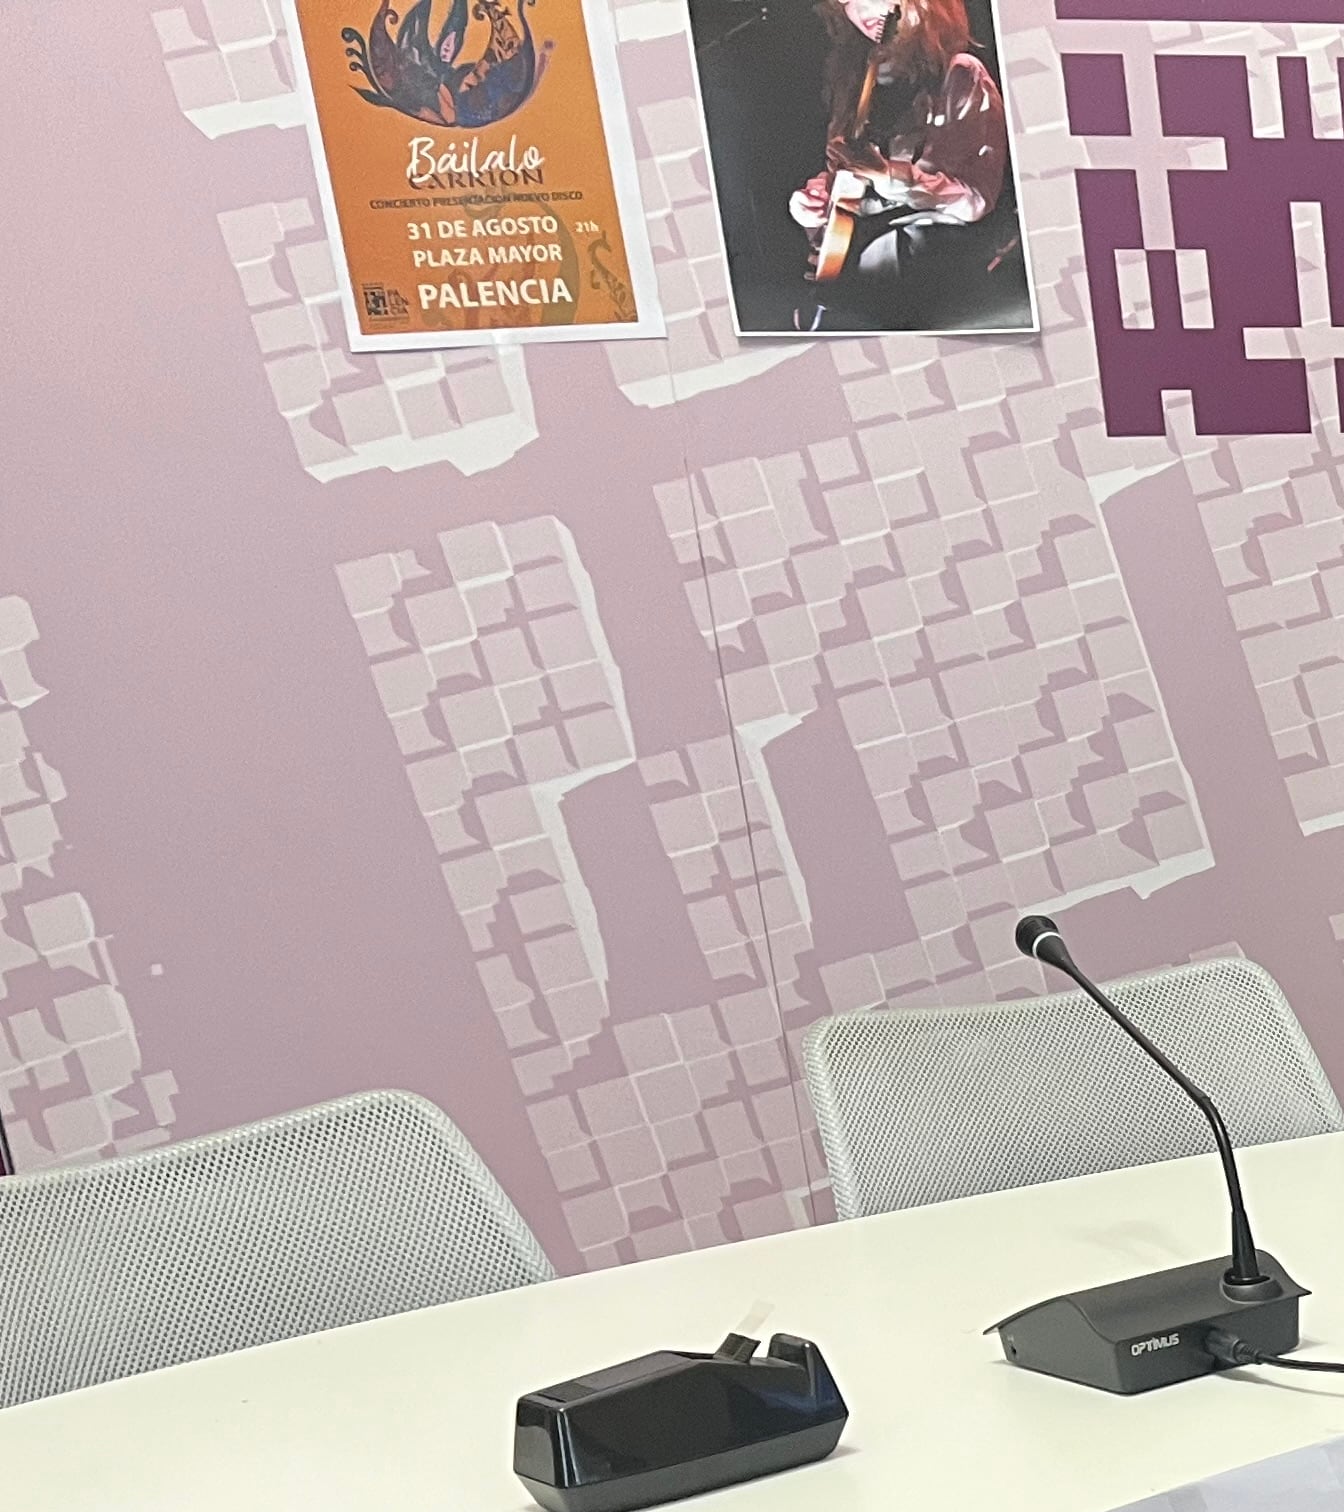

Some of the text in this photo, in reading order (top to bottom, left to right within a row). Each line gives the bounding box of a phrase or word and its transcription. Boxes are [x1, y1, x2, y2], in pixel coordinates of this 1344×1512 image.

[407, 222, 432, 240] 31
[438, 220, 466, 238] DE
[472, 216, 558, 237] AGOSTO
[413, 244, 562, 267] PLAZA MAYOR
[418, 278, 573, 310] PALENCIA
